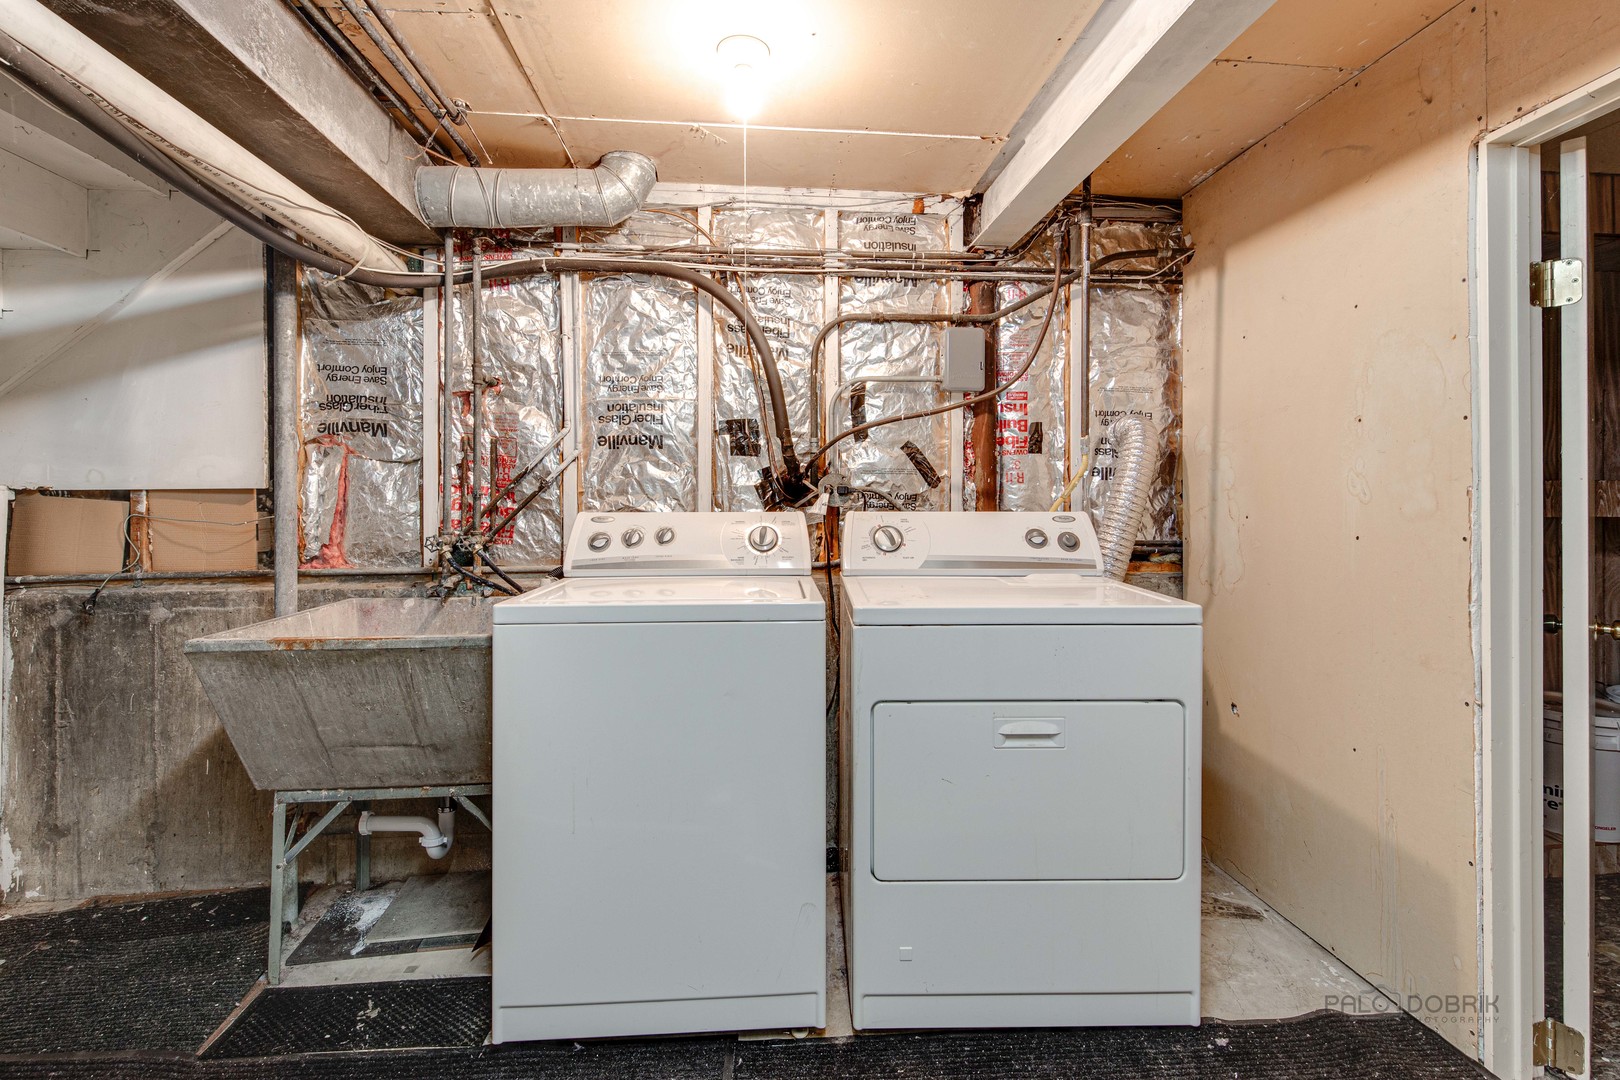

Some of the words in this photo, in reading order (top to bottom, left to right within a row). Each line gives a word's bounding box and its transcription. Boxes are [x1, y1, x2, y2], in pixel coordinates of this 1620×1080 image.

[894, 216, 916, 225] Enjoy
[895, 226, 916, 235] Save
[863, 241, 917, 251] Insulation
[726, 343, 789, 361] Mille
[317, 364, 359, 374] Comfort
[362, 365, 388, 376] Enjoy
[326, 373, 361, 384] Energy
[364, 376, 388, 385] Save
[607, 384, 640, 394] Energy
[641, 385, 664, 393] Save
[606, 403, 664, 413] Insulation
[597, 414, 664, 425] FiberGlass
[316, 422, 388, 438] Manville
[596, 434, 664, 450] Manville
[894, 492, 917, 502] Enjoy
